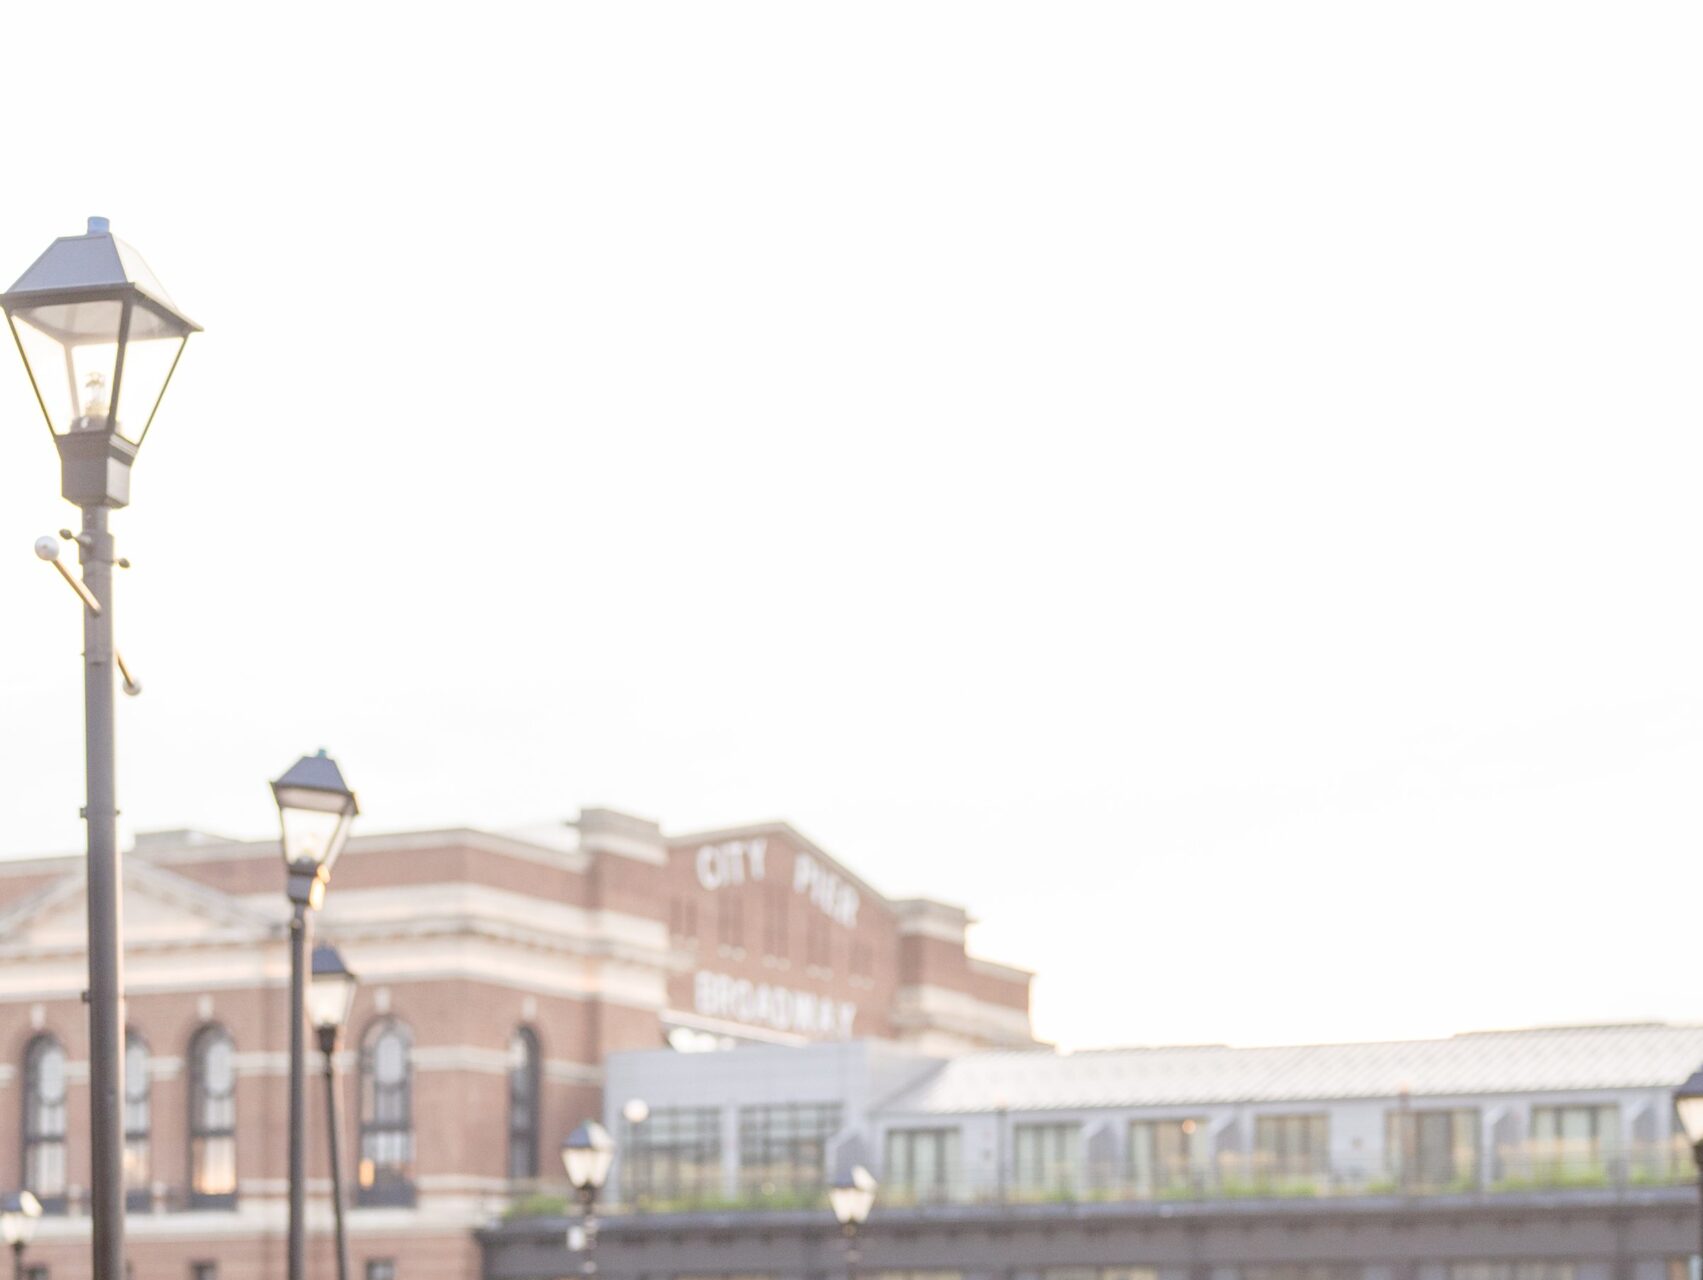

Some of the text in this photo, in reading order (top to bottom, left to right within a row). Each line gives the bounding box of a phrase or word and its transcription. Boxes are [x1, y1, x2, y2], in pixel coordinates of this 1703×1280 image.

[696, 838, 860, 928] CITY PIER
[693, 970, 857, 1040] BROADWAY
